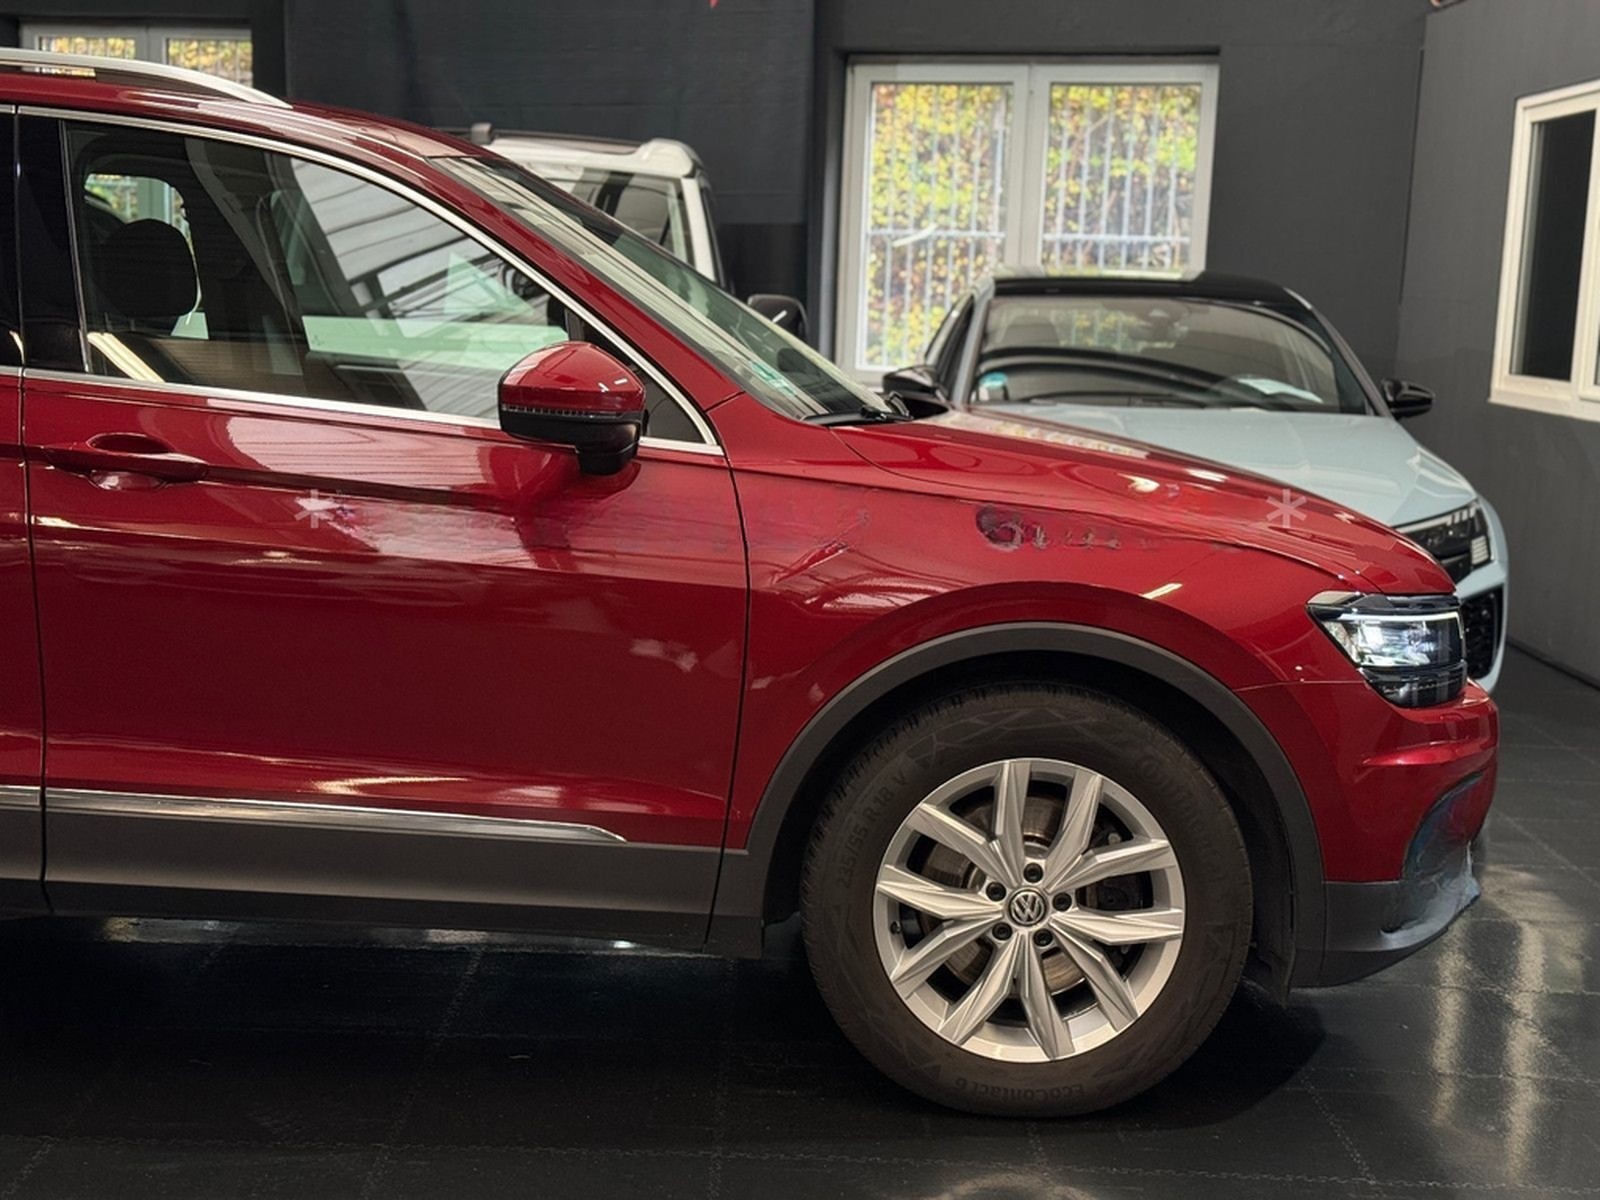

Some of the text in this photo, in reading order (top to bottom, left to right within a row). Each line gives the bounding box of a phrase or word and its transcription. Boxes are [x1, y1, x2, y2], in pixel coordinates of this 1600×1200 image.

[837, 823, 869, 889] 235/55
[890, 768, 910, 786] V
[971, 1081, 1086, 1102] EcoContact
